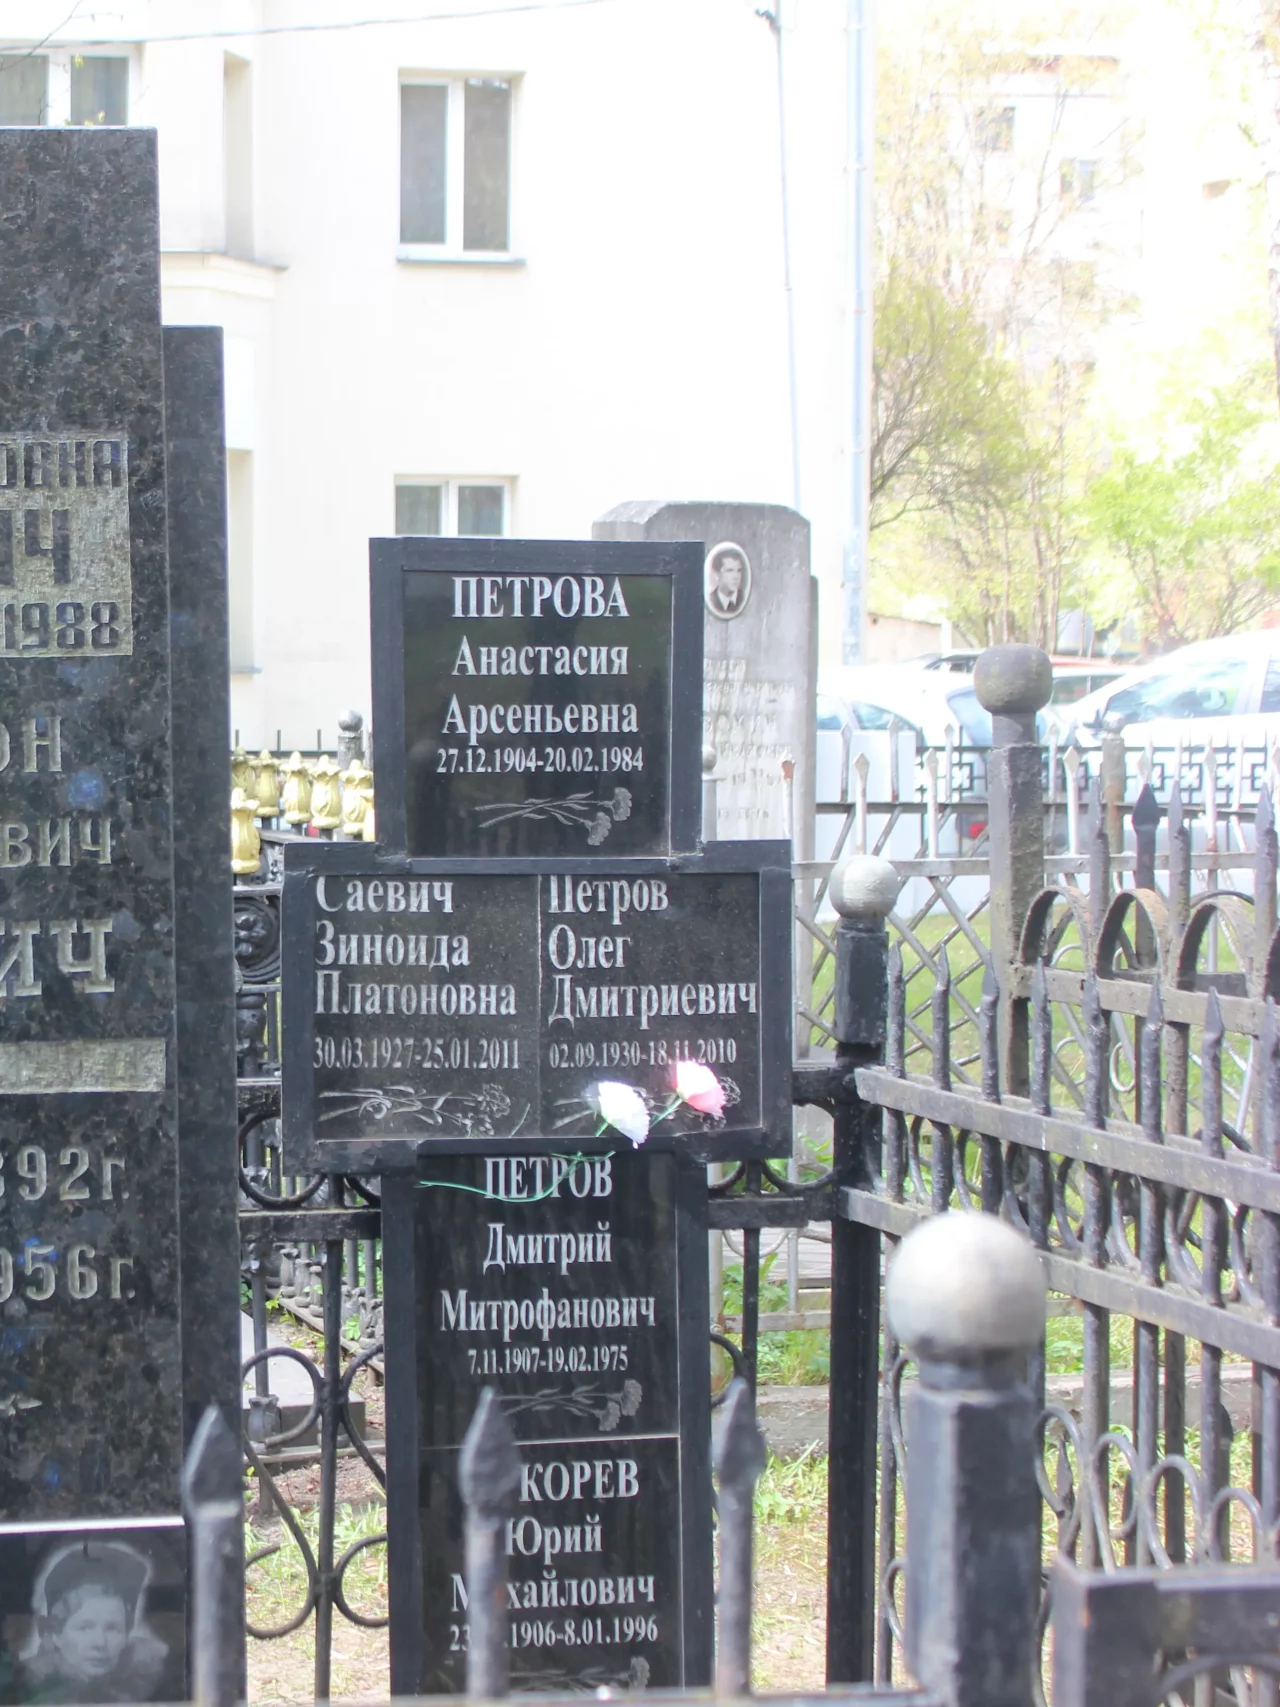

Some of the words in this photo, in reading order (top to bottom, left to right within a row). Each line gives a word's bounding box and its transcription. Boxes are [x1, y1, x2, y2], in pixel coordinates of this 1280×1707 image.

[451, 575, 630, 618] ПЕТРОВА
[4, 601, 119, 650] 1988
[451, 635, 629, 676] Анастасия
[441, 694, 640, 746] Арсеньевна
[436, 746, 644, 774] 27.12.1904-20.02.1984
[315, 875, 454, 914] Саевич
[548, 875, 669, 925] Петров
[548, 924, 631, 970] Олег
[314, 970, 517, 1016] Платоновна
[548, 975, 758, 1030] Дмитриевич
[313, 1036, 520, 1070] 30.03.1927-25.01.2011
[484, 1157, 613, 1199] ПЕТРОВ
[483, 1221, 613, 1275] Дмитрий
[439, 1288, 656, 1342] Митрофанович
[468, 1345, 629, 1375] 7.11.1907-19.02.1975
[519, 1458, 640, 1502] КОРЕВ
[506, 1513, 603, 1566] Юрий
[451, 1568, 656, 1613] Мхайлович
